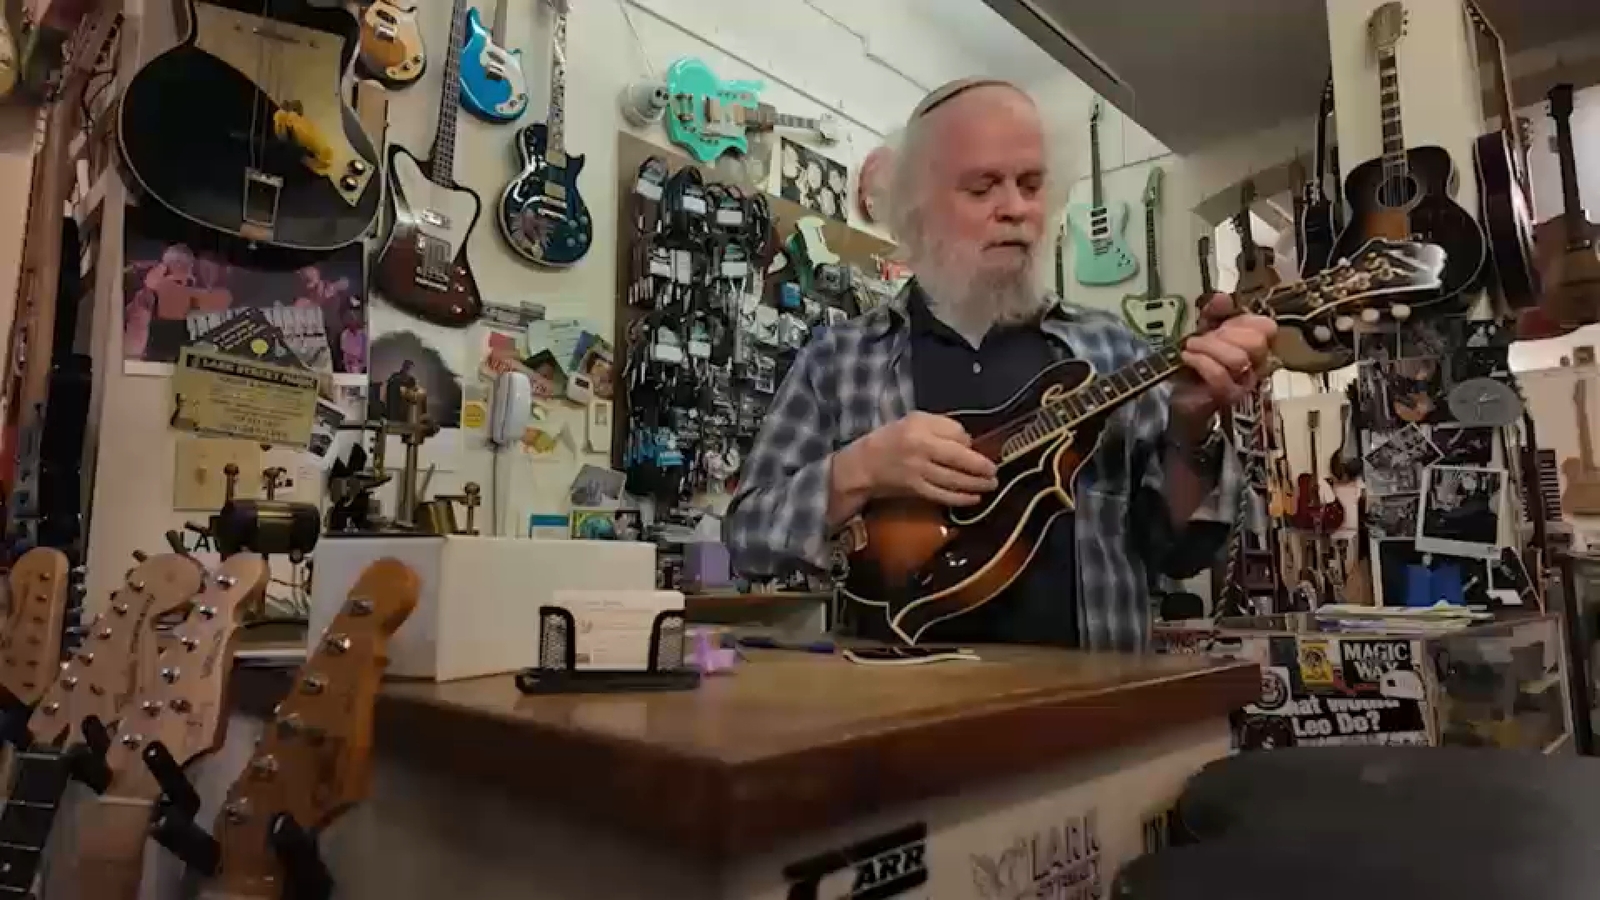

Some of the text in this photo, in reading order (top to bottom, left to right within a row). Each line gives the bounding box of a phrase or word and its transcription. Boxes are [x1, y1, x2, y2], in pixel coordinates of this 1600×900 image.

[1343, 642, 1409, 661] MAGIC
[1292, 710, 1381, 737] Leo Do?
